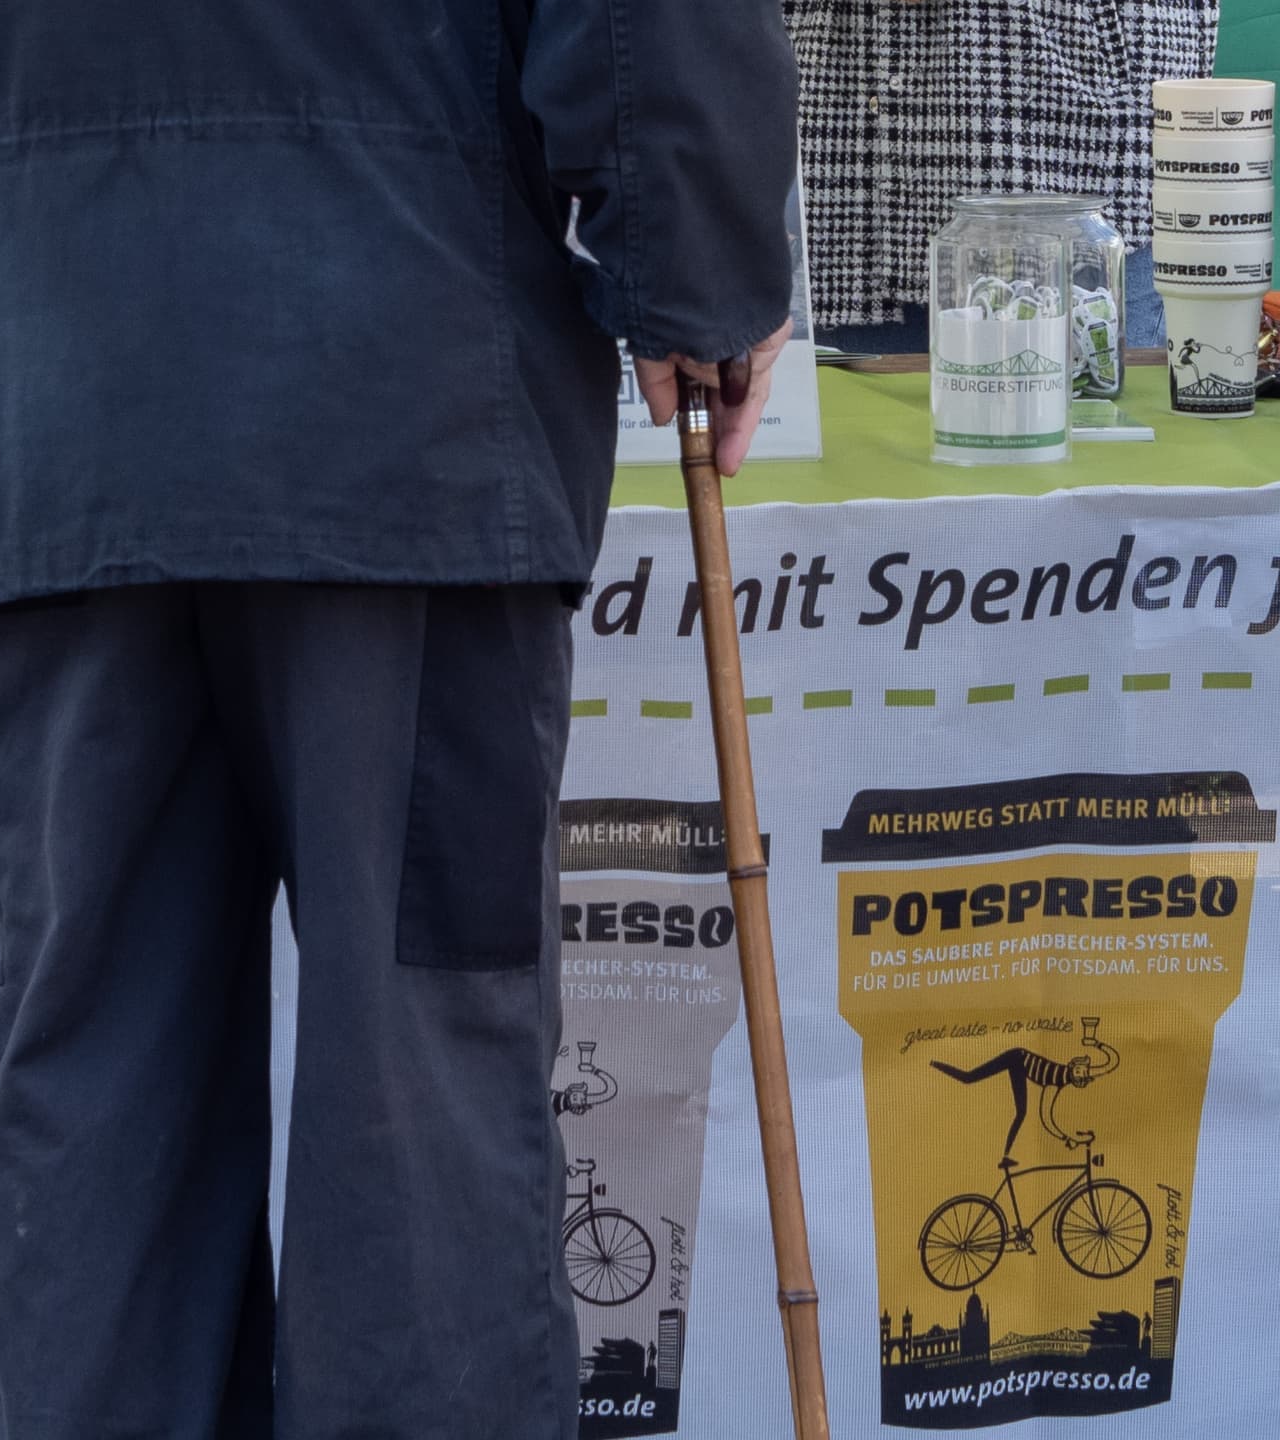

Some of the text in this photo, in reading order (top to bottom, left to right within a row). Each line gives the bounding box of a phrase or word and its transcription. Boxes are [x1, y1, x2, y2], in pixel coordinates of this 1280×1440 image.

[1155, 160, 1240, 175] POTSPRESSO
[951, 377, 1064, 393] BÜRGERSTIFTUNG
[859, 533, 1238, 651] Spenden
[868, 793, 1232, 835] MEHRWEG STATT MEHR MÜLL:
[569, 823, 726, 847] MEHR MÜLL:
[851, 873, 1238, 937] POTSPRESSO
[870, 933, 1214, 968] DAS SAUBERE PFANDBECHER-SYSTEM.
[853, 954, 1229, 992] FÜR DIE UMWELT. FÜR POTSDAM. FÜR UNS.
[646, 983, 679, 1002] FÜR
[686, 987, 727, 1005] UNS.
[900, 1016, 1074, 1054] great taste no waste
[904, 1365, 1151, 1412] www.potspresso.de
